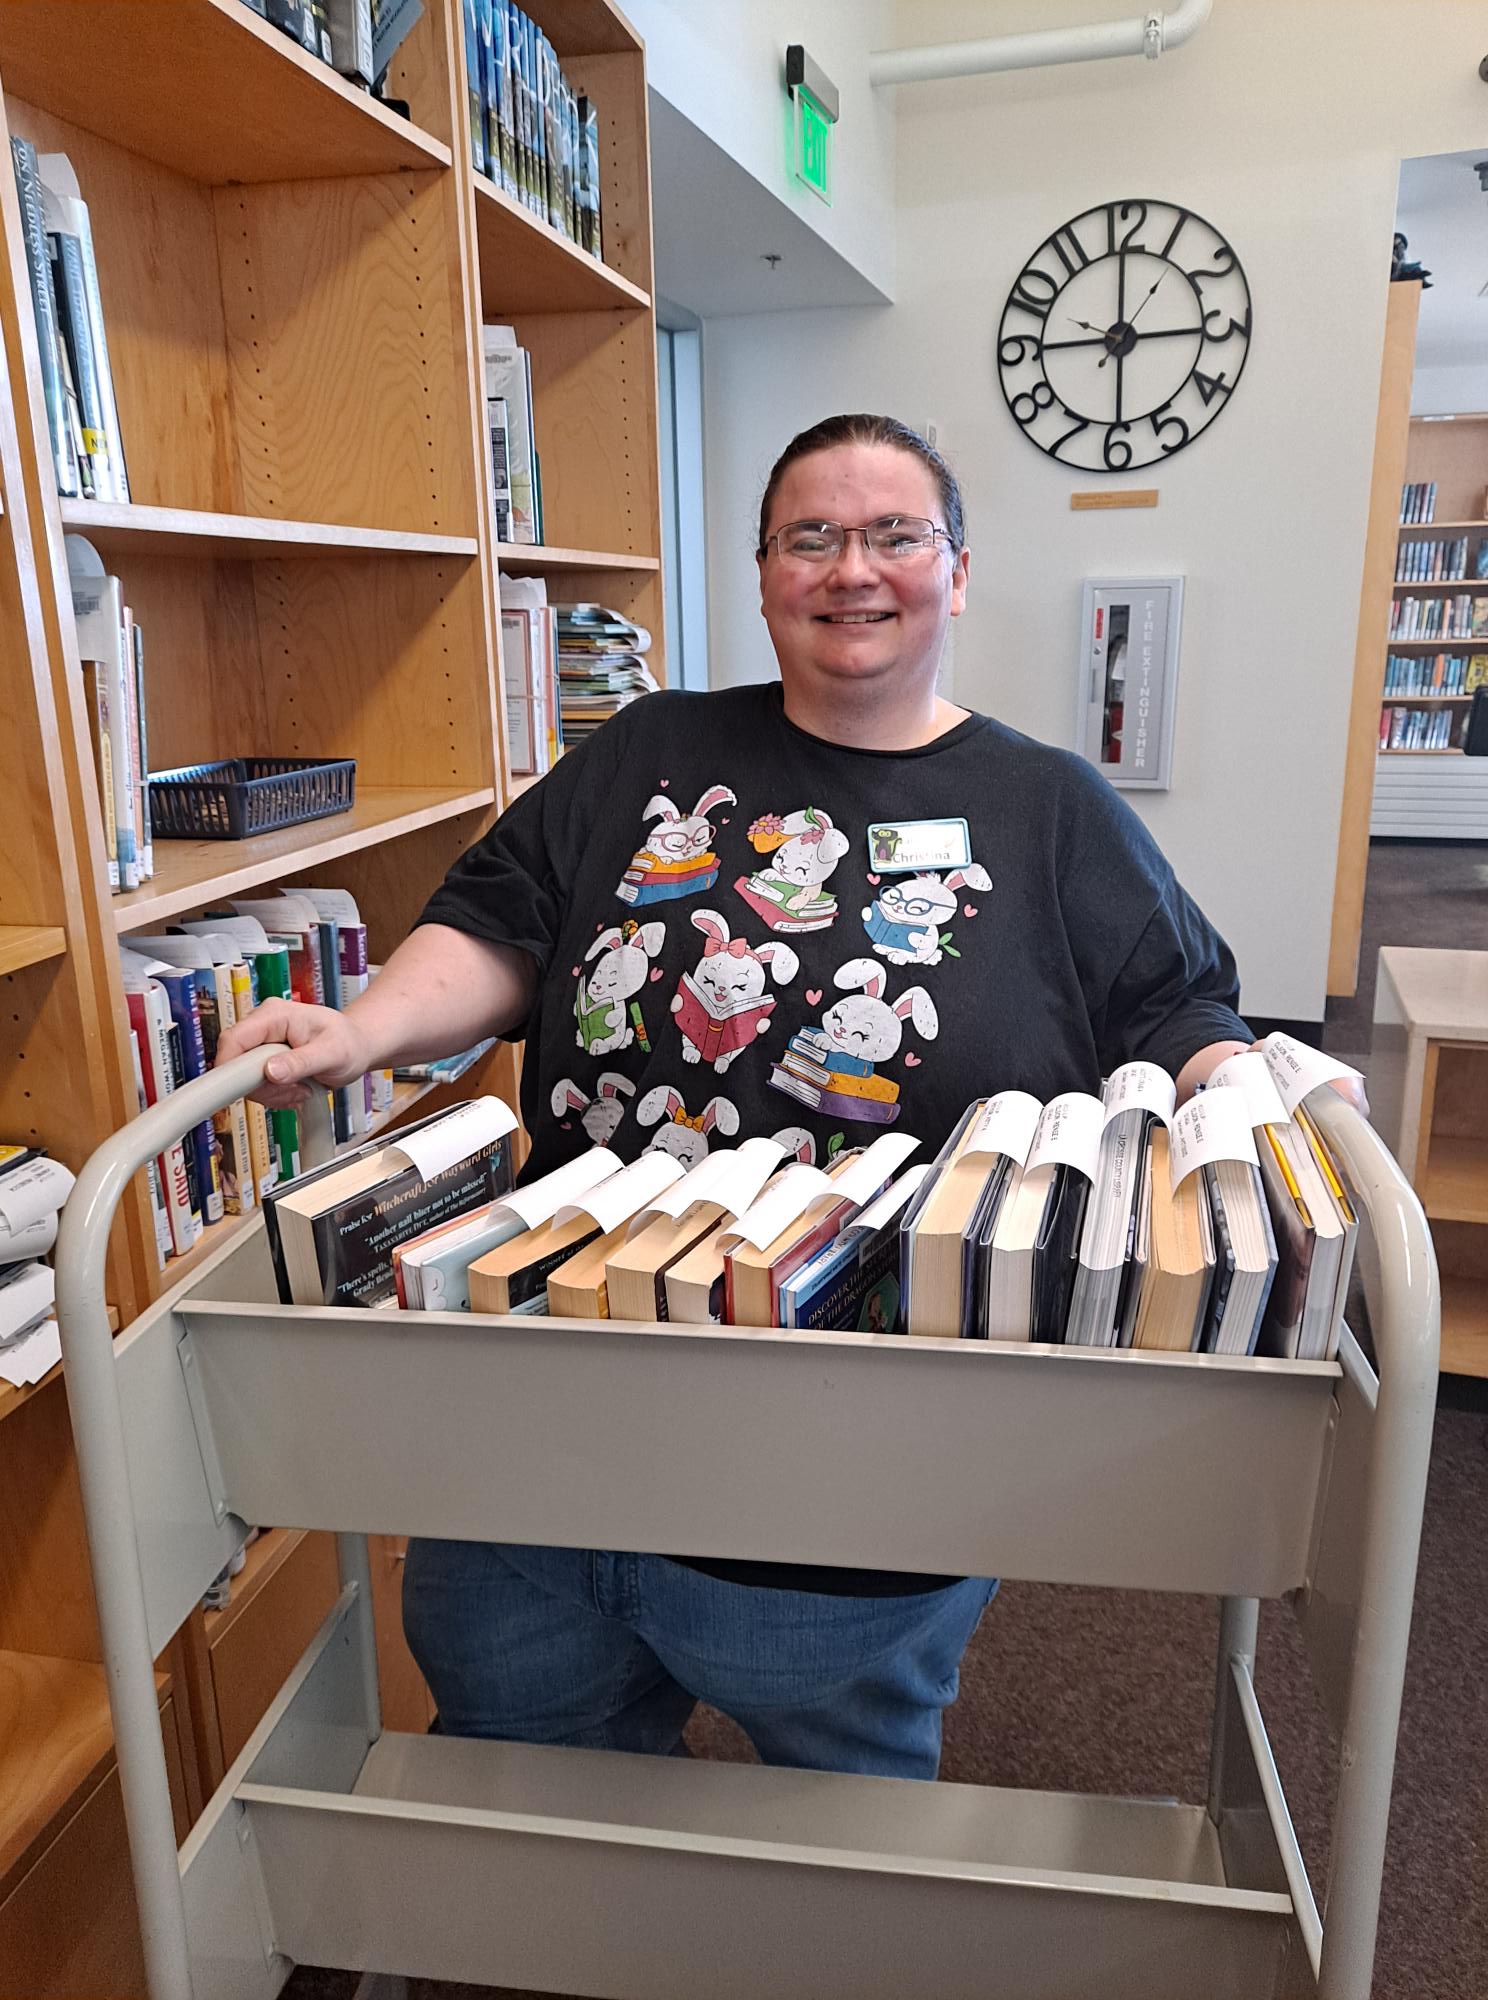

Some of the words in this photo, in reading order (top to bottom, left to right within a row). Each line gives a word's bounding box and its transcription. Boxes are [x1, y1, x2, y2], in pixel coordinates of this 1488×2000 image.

[1050, 225, 1092, 277] 11
[1105, 202, 1147, 254] 12
[1161, 211, 1190, 259] 1
[1008, 268, 1059, 321] 10
[1188, 245, 1236, 296] 2
[1203, 307, 1251, 344] 3
[1000, 335, 1043, 366] 9
[1010, 381, 1055, 424] 8
[1192, 368, 1232, 407] 4
[1049, 408, 1090, 457] 7
[1104, 422, 1132, 471] 6
[1151, 402, 1189, 453] 5
[1143, 600, 1155, 641] FIRE
[1135, 647, 1152, 768] EXTINGUISHER
[156, 1028, 169, 1065] MEGAN
[171, 1161, 191, 1207] SAID
[339, 1221, 362, 1236] Praise
[359, 1211, 375, 1223] for
[374, 1184, 424, 1216] Witchcraft
[481, 1140, 503, 1158] Girls
[809, 1282, 850, 1325] DISCOVER
